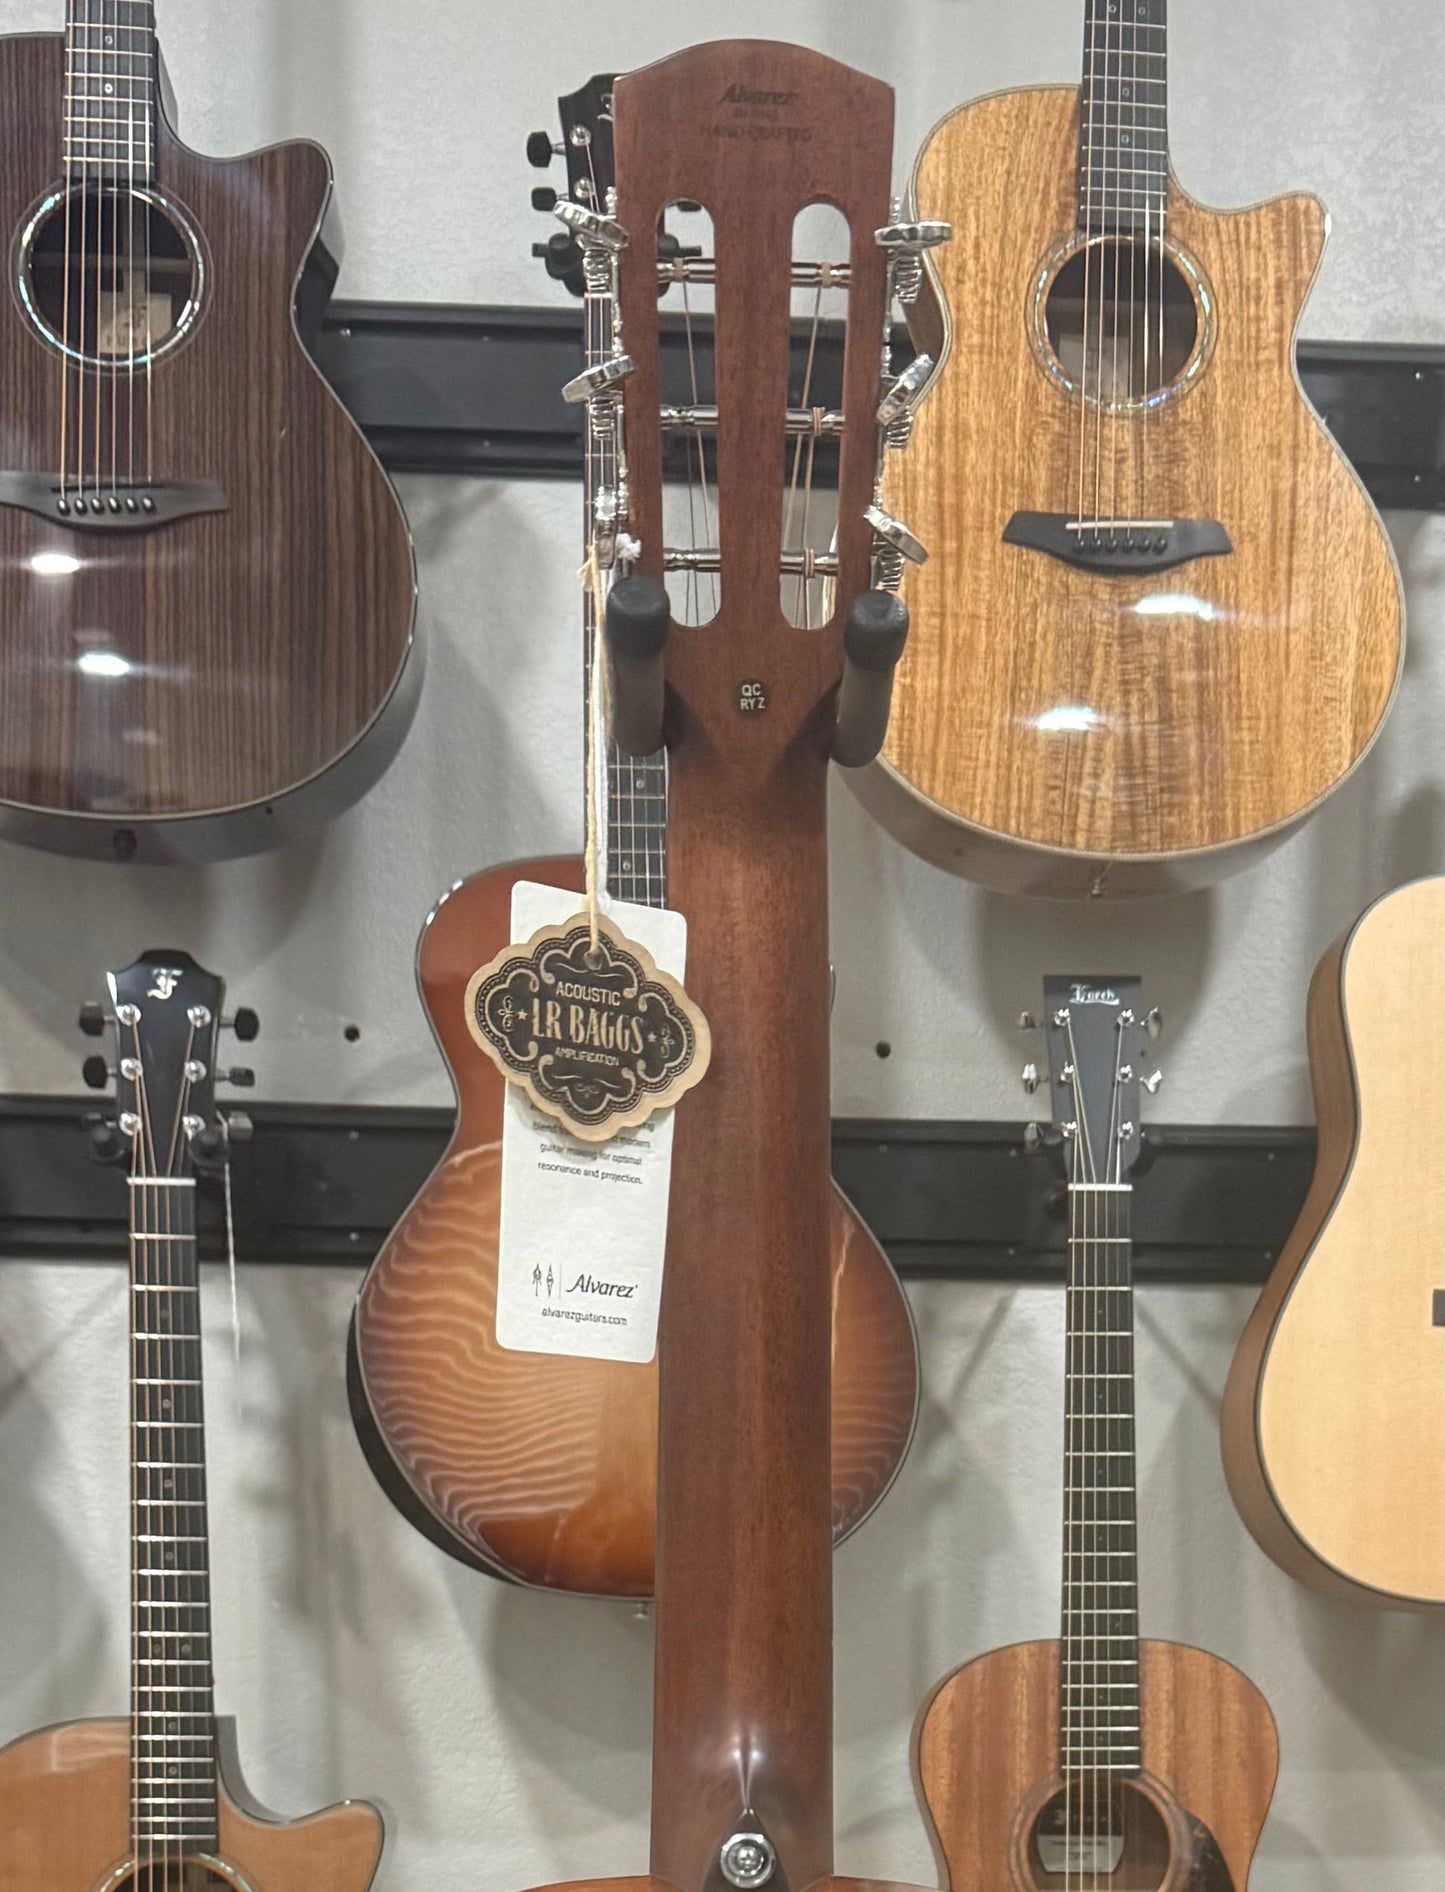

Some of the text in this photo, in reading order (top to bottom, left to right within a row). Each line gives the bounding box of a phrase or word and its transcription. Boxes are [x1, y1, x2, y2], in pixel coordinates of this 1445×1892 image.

[741, 683, 761, 697] QC
[556, 981, 622, 1006] ACOUSTIC
[531, 997, 645, 1054] LR BAGGS
[555, 1046, 620, 1067] AMPLIFICATION
[540, 1143, 564, 1153] guitar
[612, 1154, 642, 1167] optimal
[537, 1161, 643, 1185] resonance and projection.
[565, 1273, 635, 1299] Alvarez
[541, 1306, 628, 1326] alvarezguitars.com
